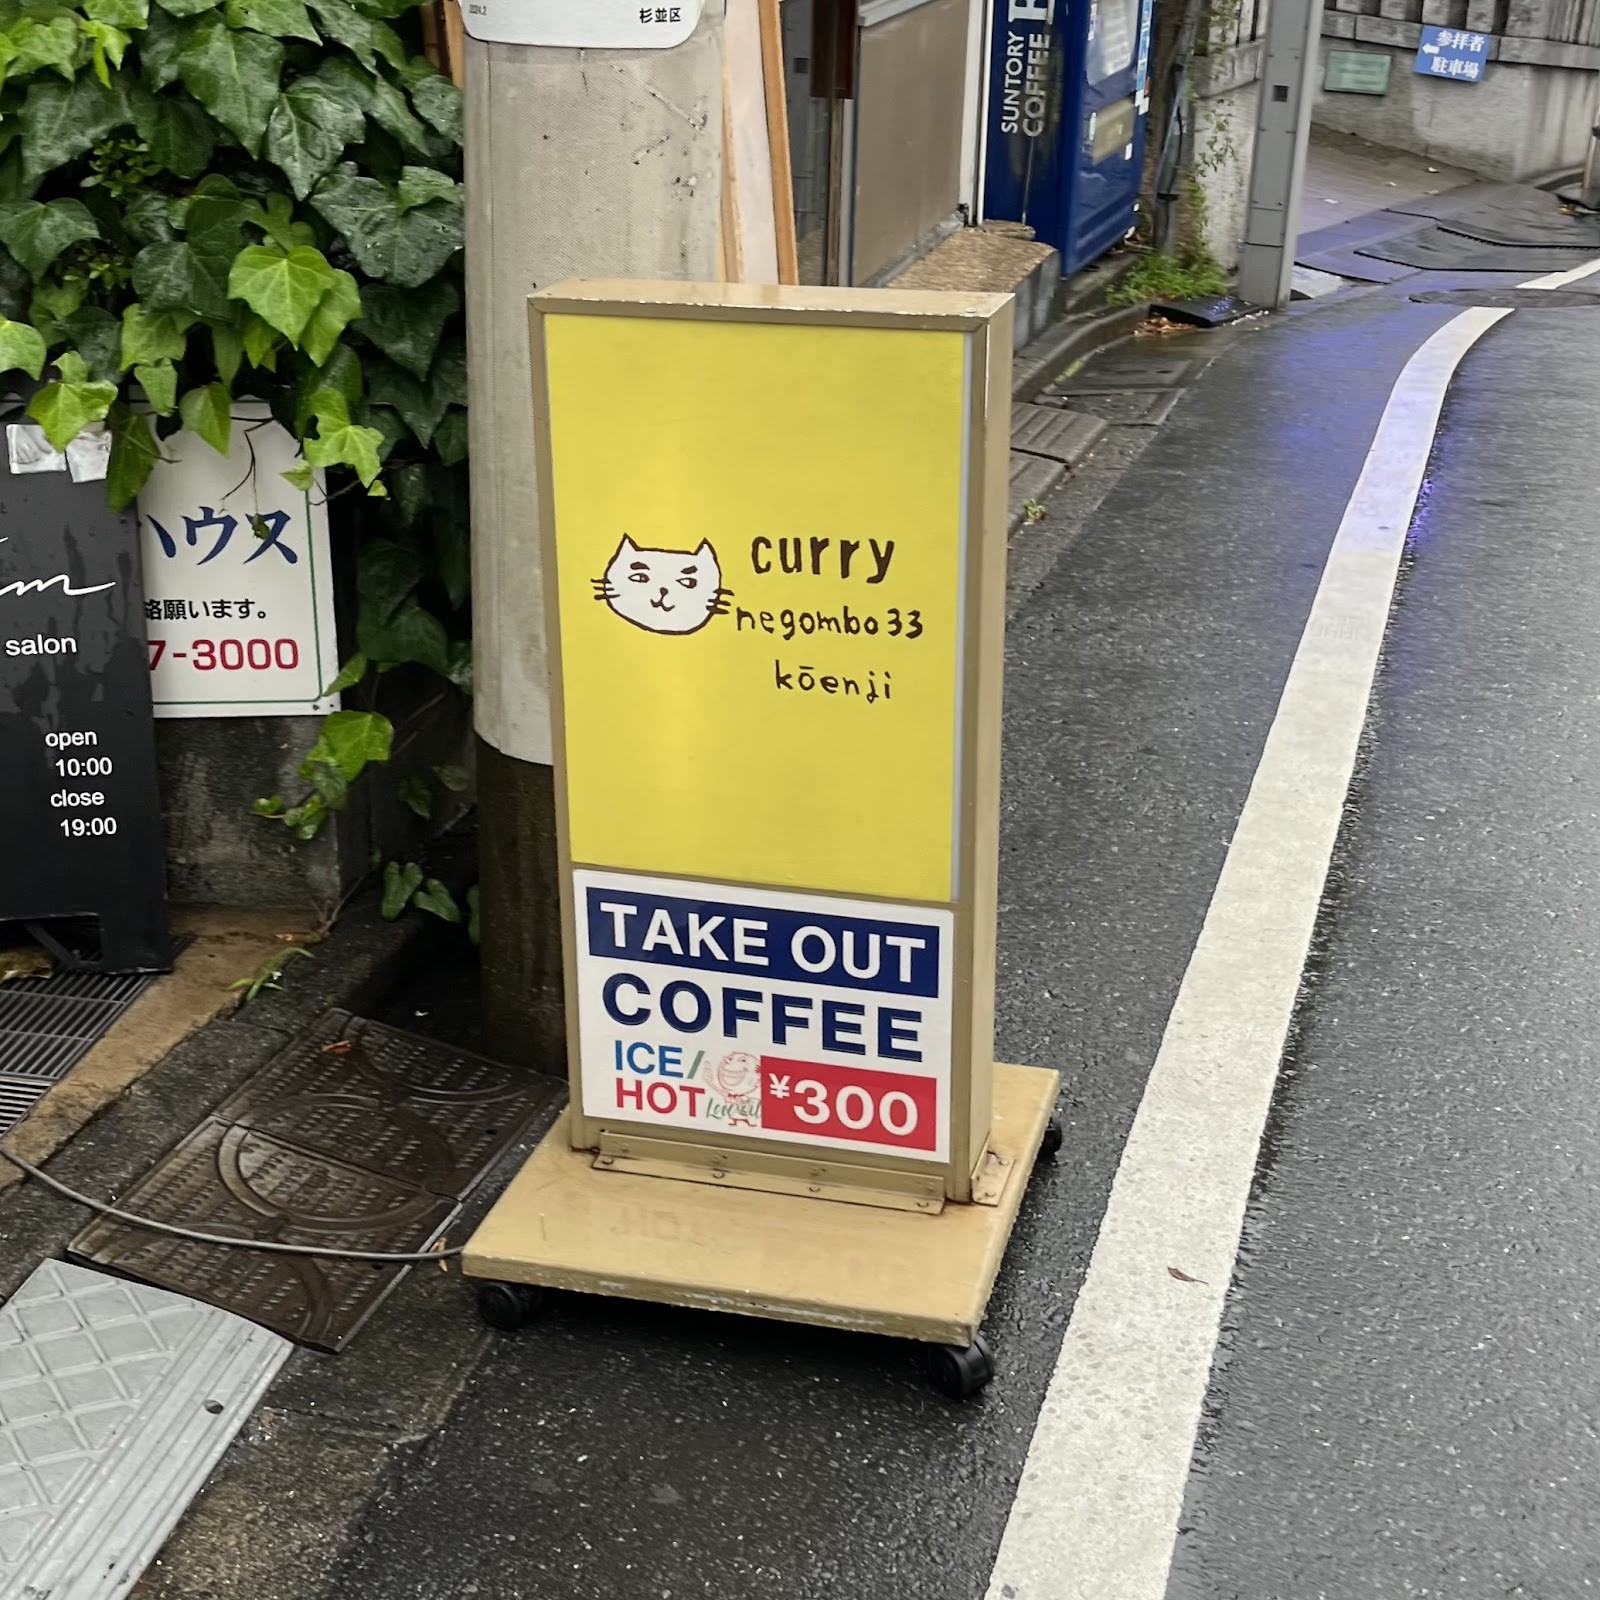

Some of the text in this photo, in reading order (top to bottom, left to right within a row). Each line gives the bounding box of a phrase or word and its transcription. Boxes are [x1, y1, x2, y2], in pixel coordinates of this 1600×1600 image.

[639, 7, 682, 23] 杉並区
[1436, 30, 1485, 53] 参拝者
[1001, 31, 1025, 134] SUNTORY
[1022, 33, 1050, 137] COFFEE
[1430, 56, 1480, 79] 駐車場
[751, 535, 894, 584] curry
[736, 605, 924, 641] negombo33
[5, 634, 78, 656] salon
[775, 659, 892, 704] kōenji
[45, 731, 98, 750] open
[55, 757, 113, 777] 10:00
[50, 789, 105, 807] close
[60, 817, 117, 837] 19:00
[600, 902, 926, 983] TAKE OUT
[602, 973, 923, 1063] COFFEE
[616, 1077, 705, 1118] HOT
[768, 1073, 919, 1137] ¥300
